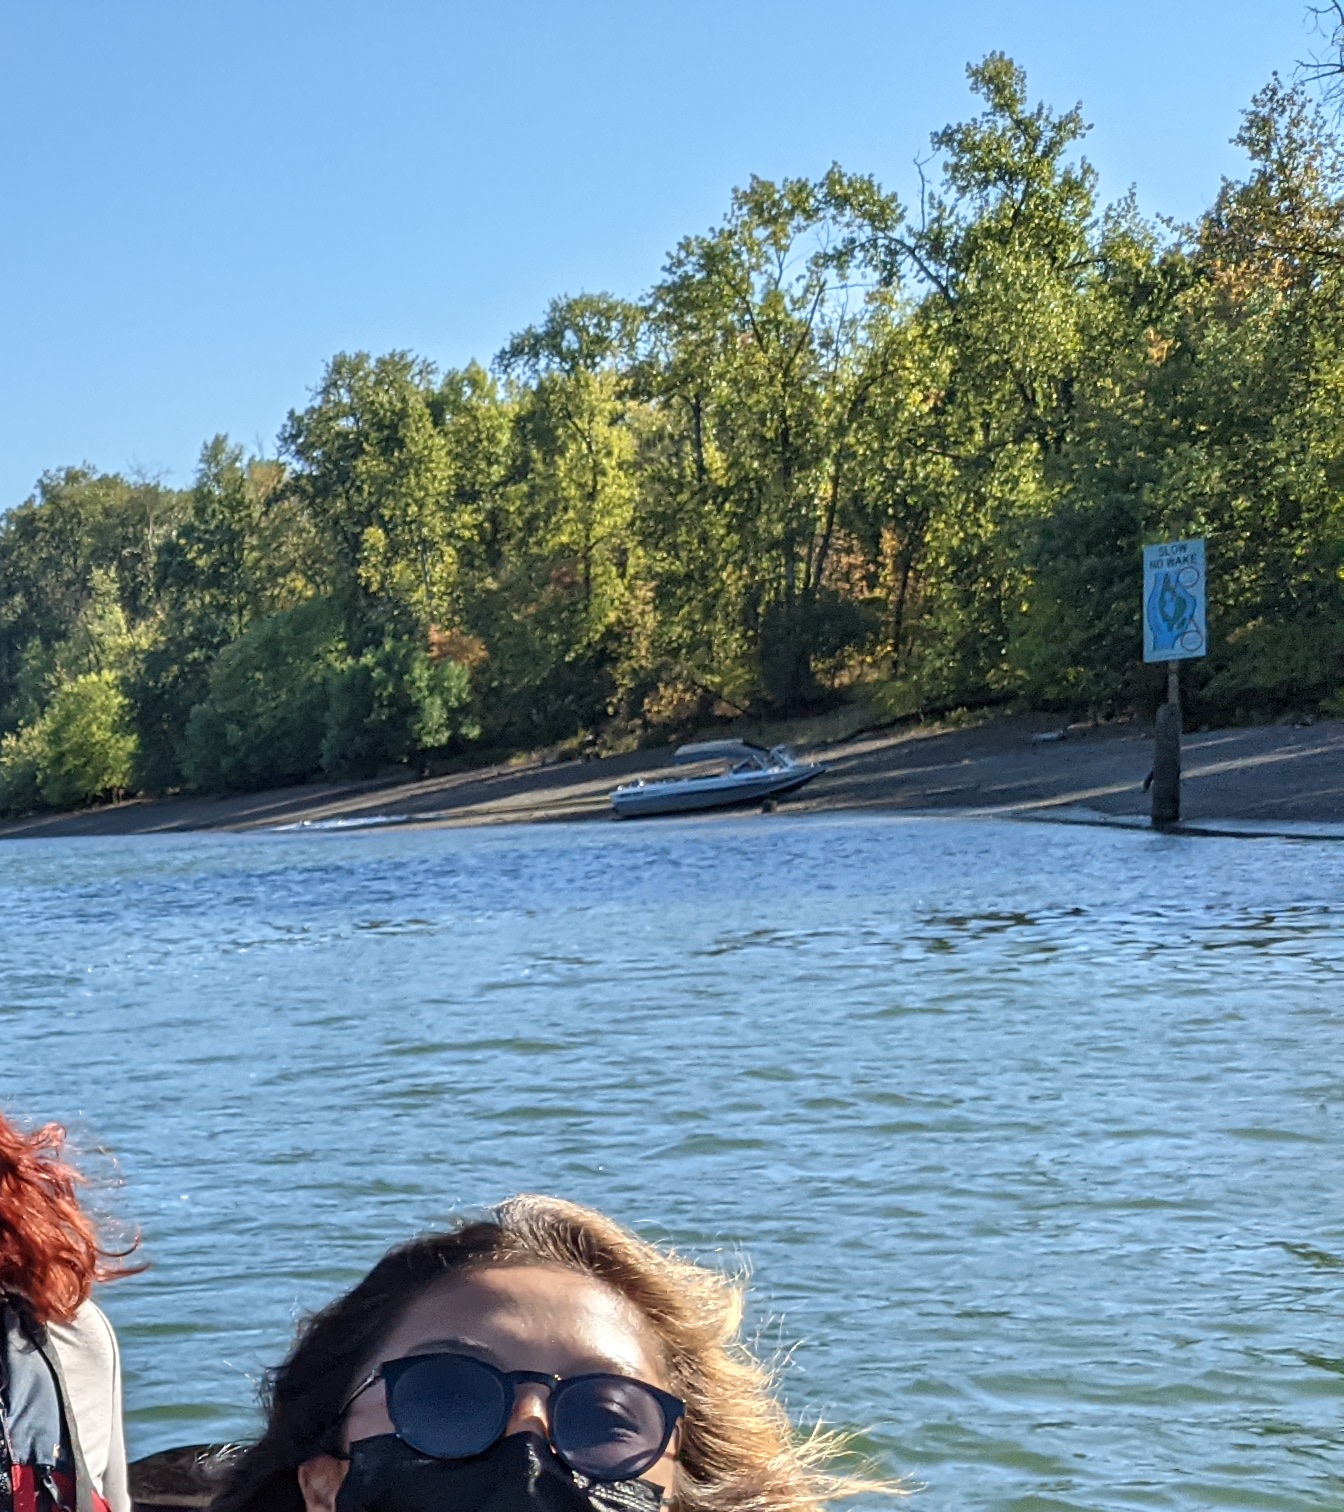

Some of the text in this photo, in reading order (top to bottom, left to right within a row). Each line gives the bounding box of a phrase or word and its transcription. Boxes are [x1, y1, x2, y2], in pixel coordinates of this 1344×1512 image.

[1158, 543, 1188, 557] SLOW
[1150, 552, 1197, 569] NO WAKE
